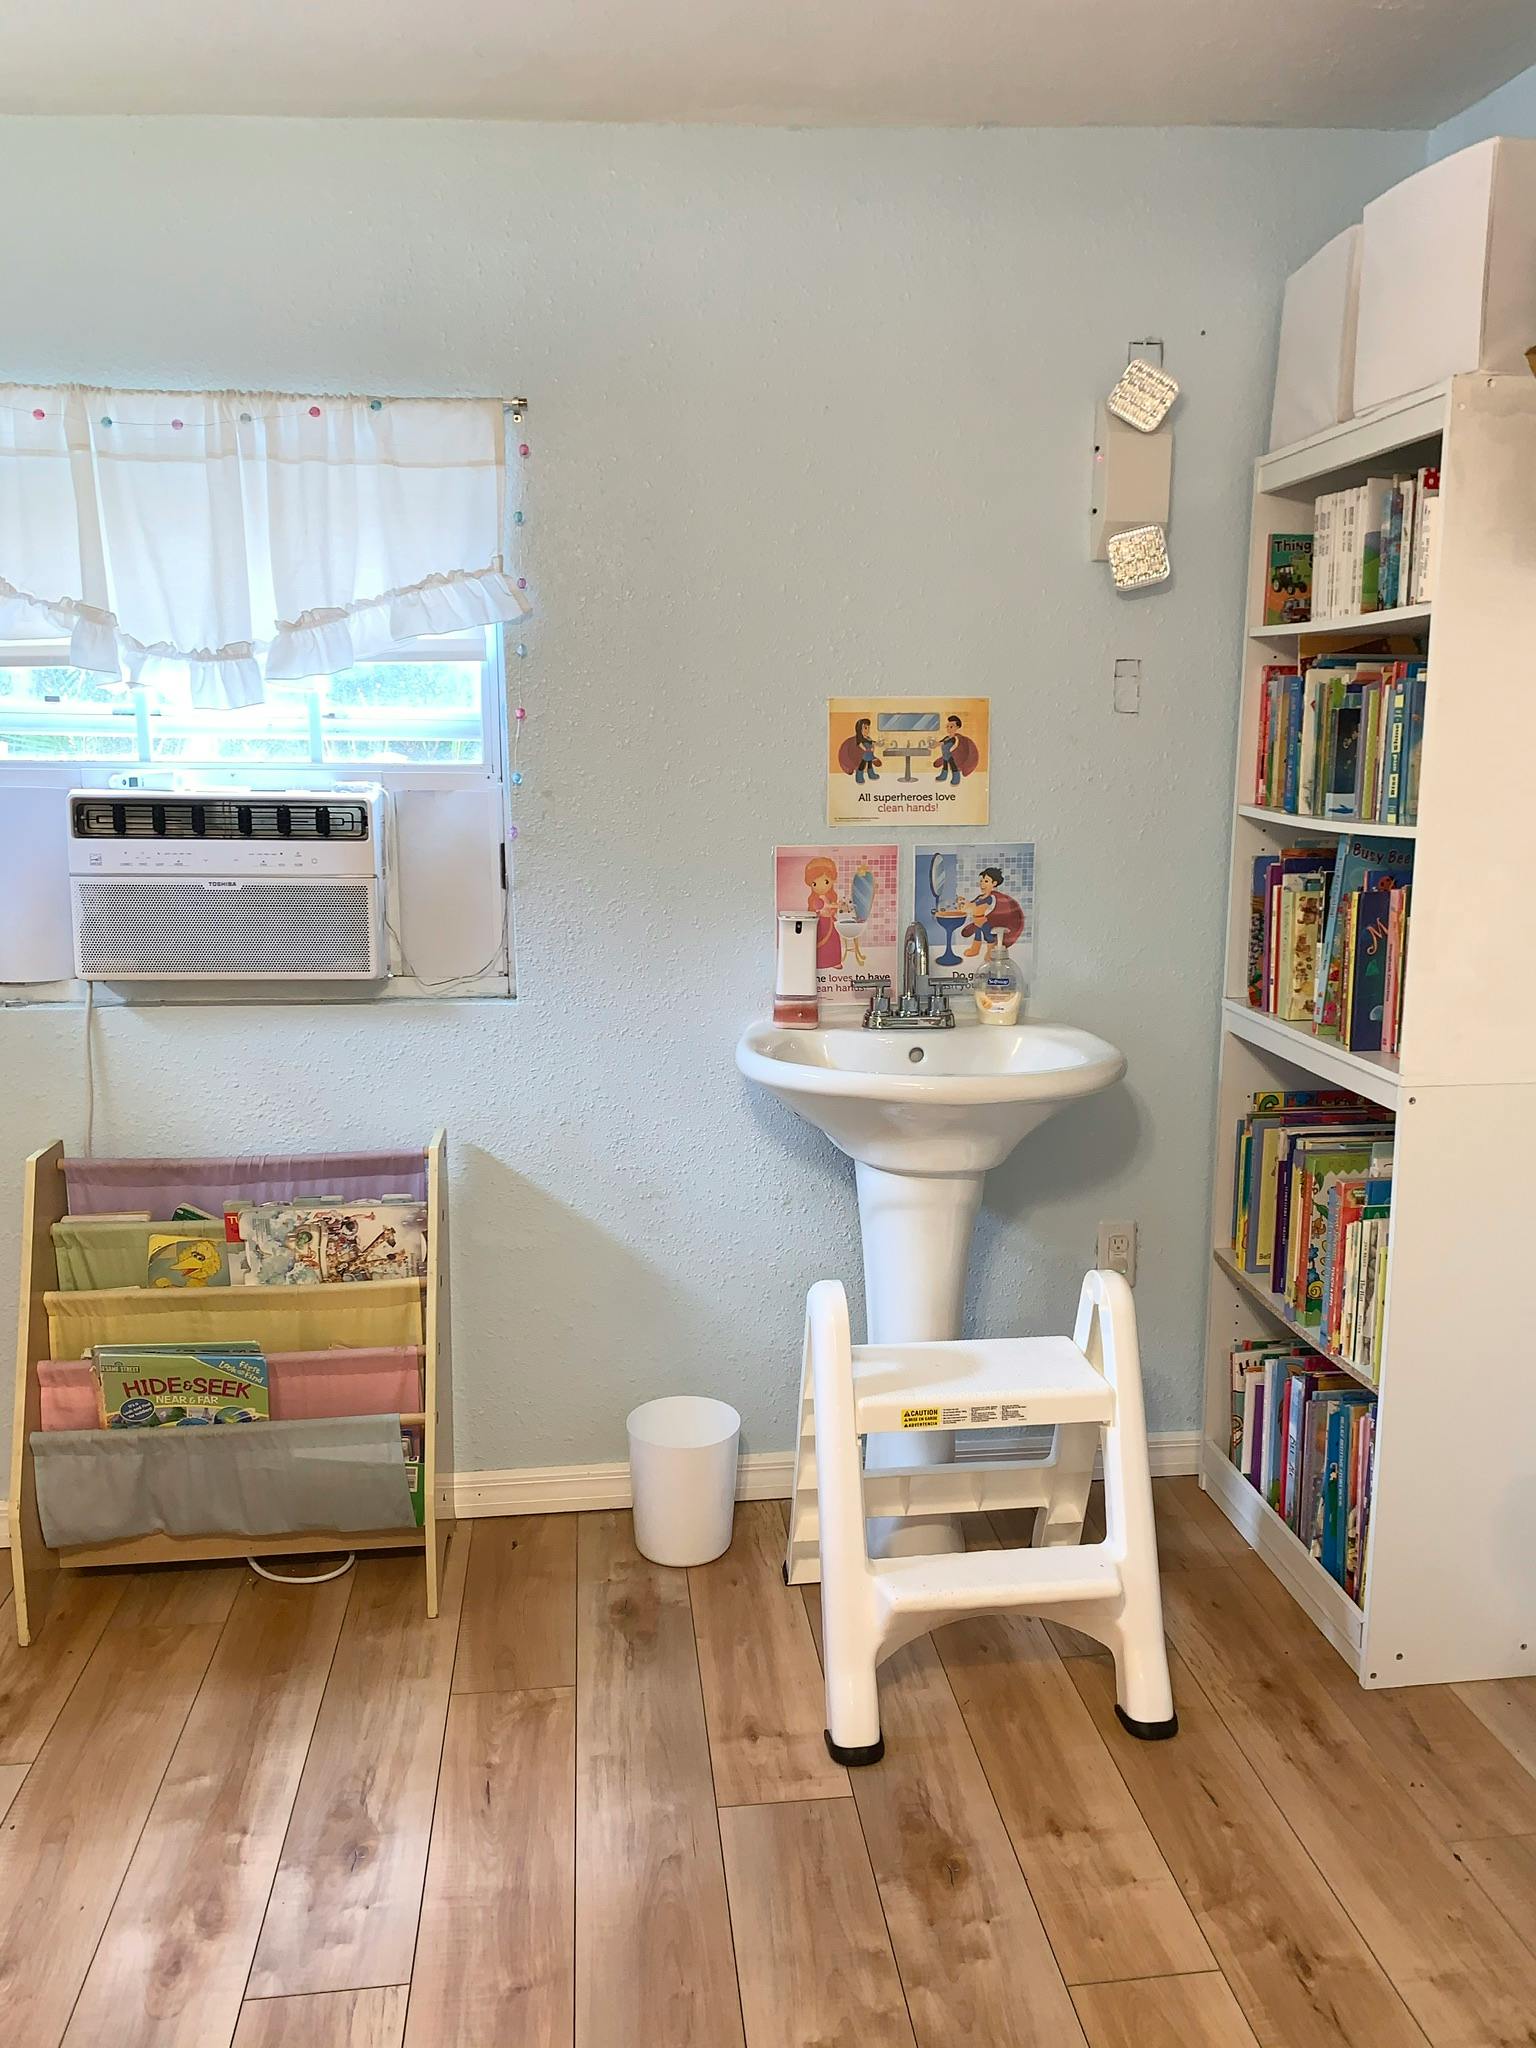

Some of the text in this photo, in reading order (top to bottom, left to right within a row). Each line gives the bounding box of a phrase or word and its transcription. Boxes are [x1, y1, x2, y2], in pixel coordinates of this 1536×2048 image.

[858, 793, 956, 804] All superheroes love
[877, 803, 939, 813] clean hands!
[1353, 843, 1383, 865] Busy
[828, 974, 853, 982] loves
[855, 973, 866, 981] to
[867, 973, 891, 981] have
[952, 971, 966, 980] Do
[219, 1360, 237, 1374] Look
[244, 1369, 264, 1384] Find
[122, 1376, 252, 1399] HIDE & SEEK
[155, 1395, 219, 1405] NEAR & FAR
